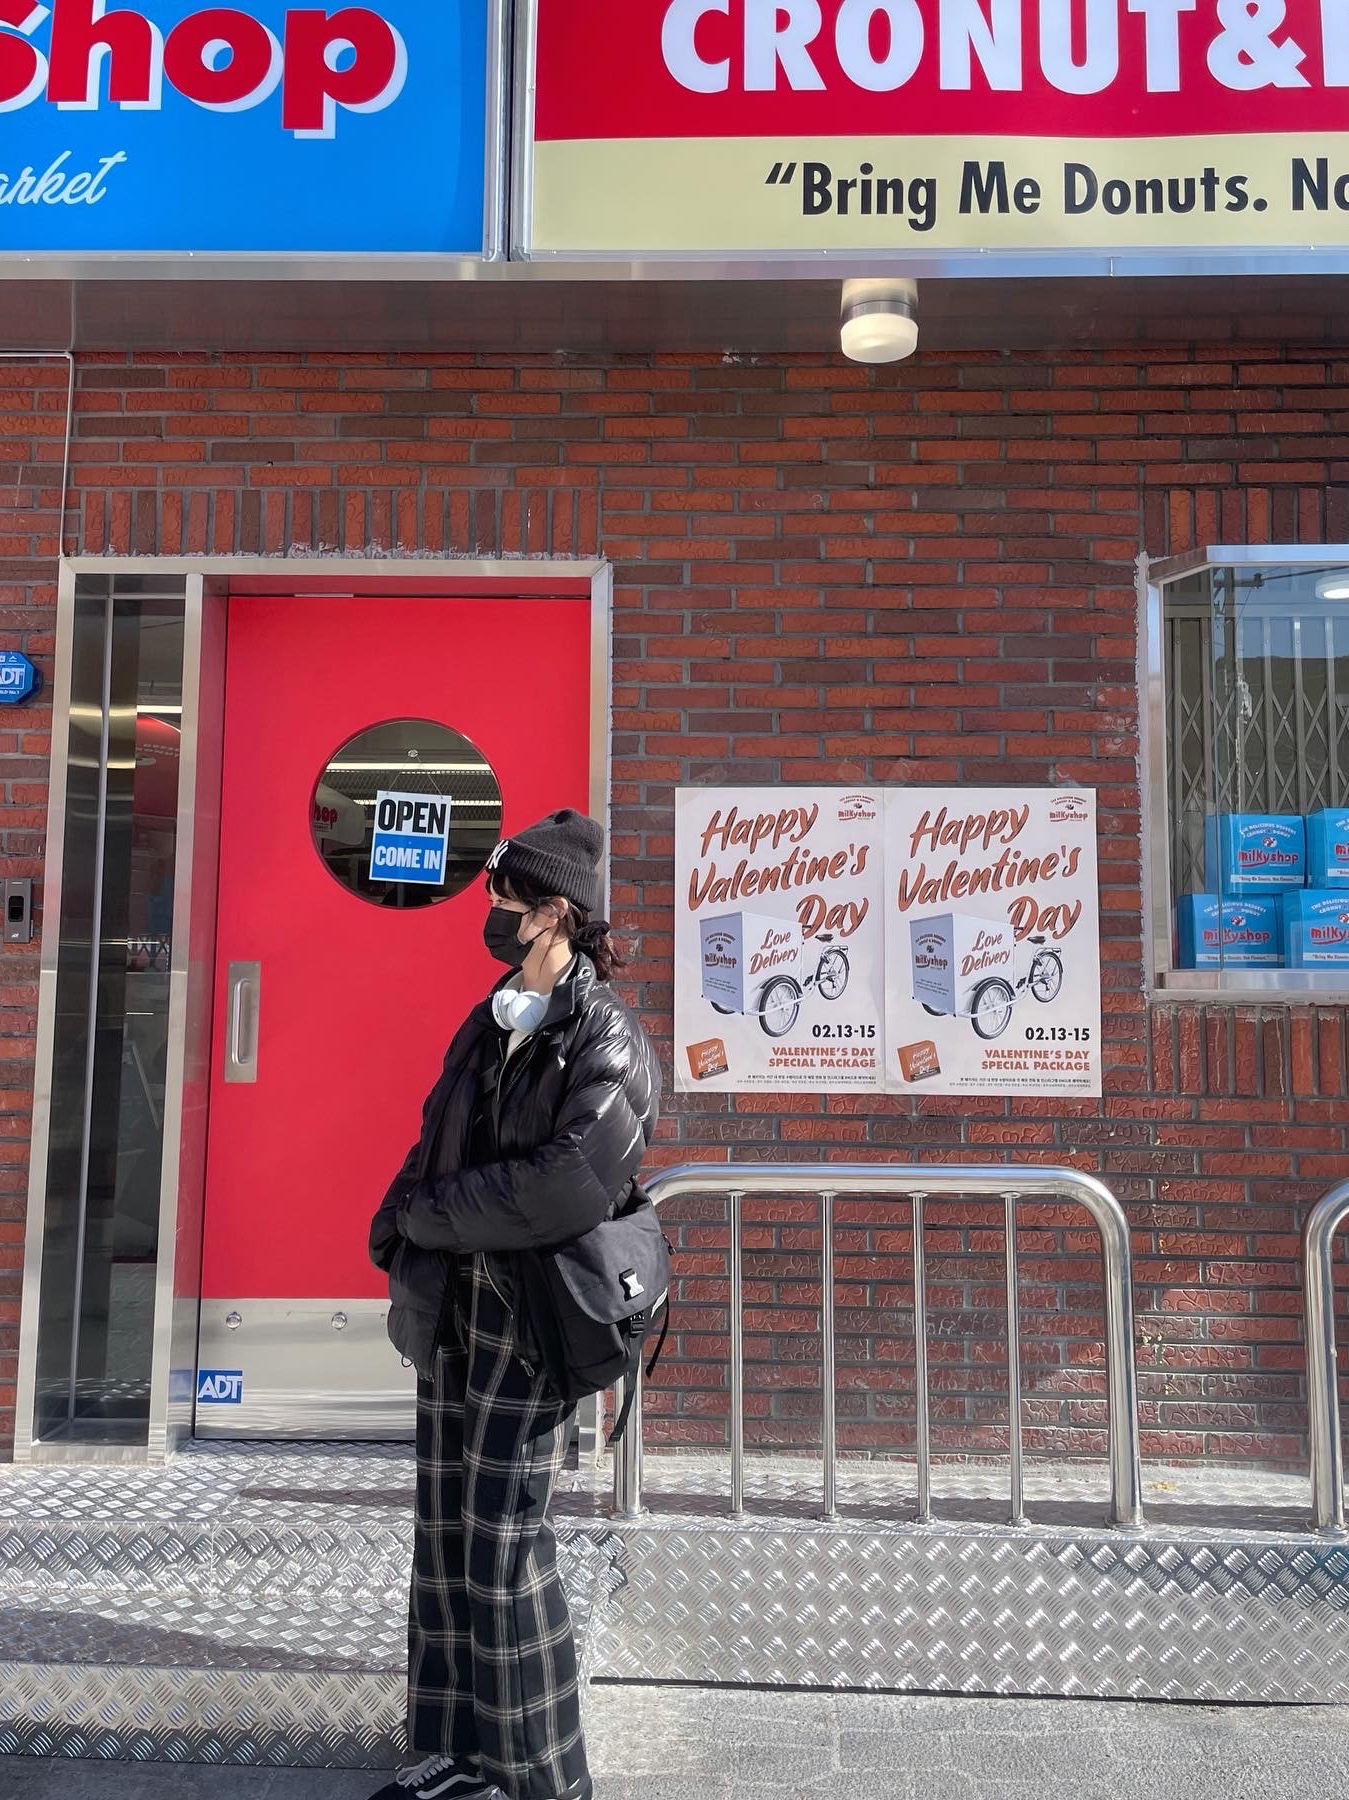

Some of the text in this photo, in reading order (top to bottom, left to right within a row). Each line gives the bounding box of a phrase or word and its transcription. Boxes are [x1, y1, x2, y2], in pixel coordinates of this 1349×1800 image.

[958, 160, 1040, 215] Me
[1063, 161, 1268, 215] Donuts.
[0, 667, 23, 685] DT
[377, 798, 447, 835] OPEN
[700, 803, 819, 858] Happy
[910, 804, 1030, 859] Happy
[374, 845, 441, 870] COME IN
[687, 843, 870, 911] Valentine's
[898, 845, 1082, 912] Valentine's
[796, 894, 869, 939] Day
[1008, 895, 1082, 942] Day
[760, 928, 792, 951] Love
[972, 930, 1003, 952] Love
[749, 945, 800, 976] Delivery
[960, 947, 1011, 977] Delivery
[812, 1024, 876, 1039] 02.13-15
[1025, 1027, 1090, 1042] 02.13-15
[768, 1058, 876, 1068] SPECIAL PACKAGE
[772, 1046, 876, 1057] VALENTINE'S DAY
[984, 1048, 1090, 1060] VALENTINE'S DAY
[981, 1060, 1091, 1071] SPECIAL PACKAGE
[198, 1375, 243, 1399] ADT
